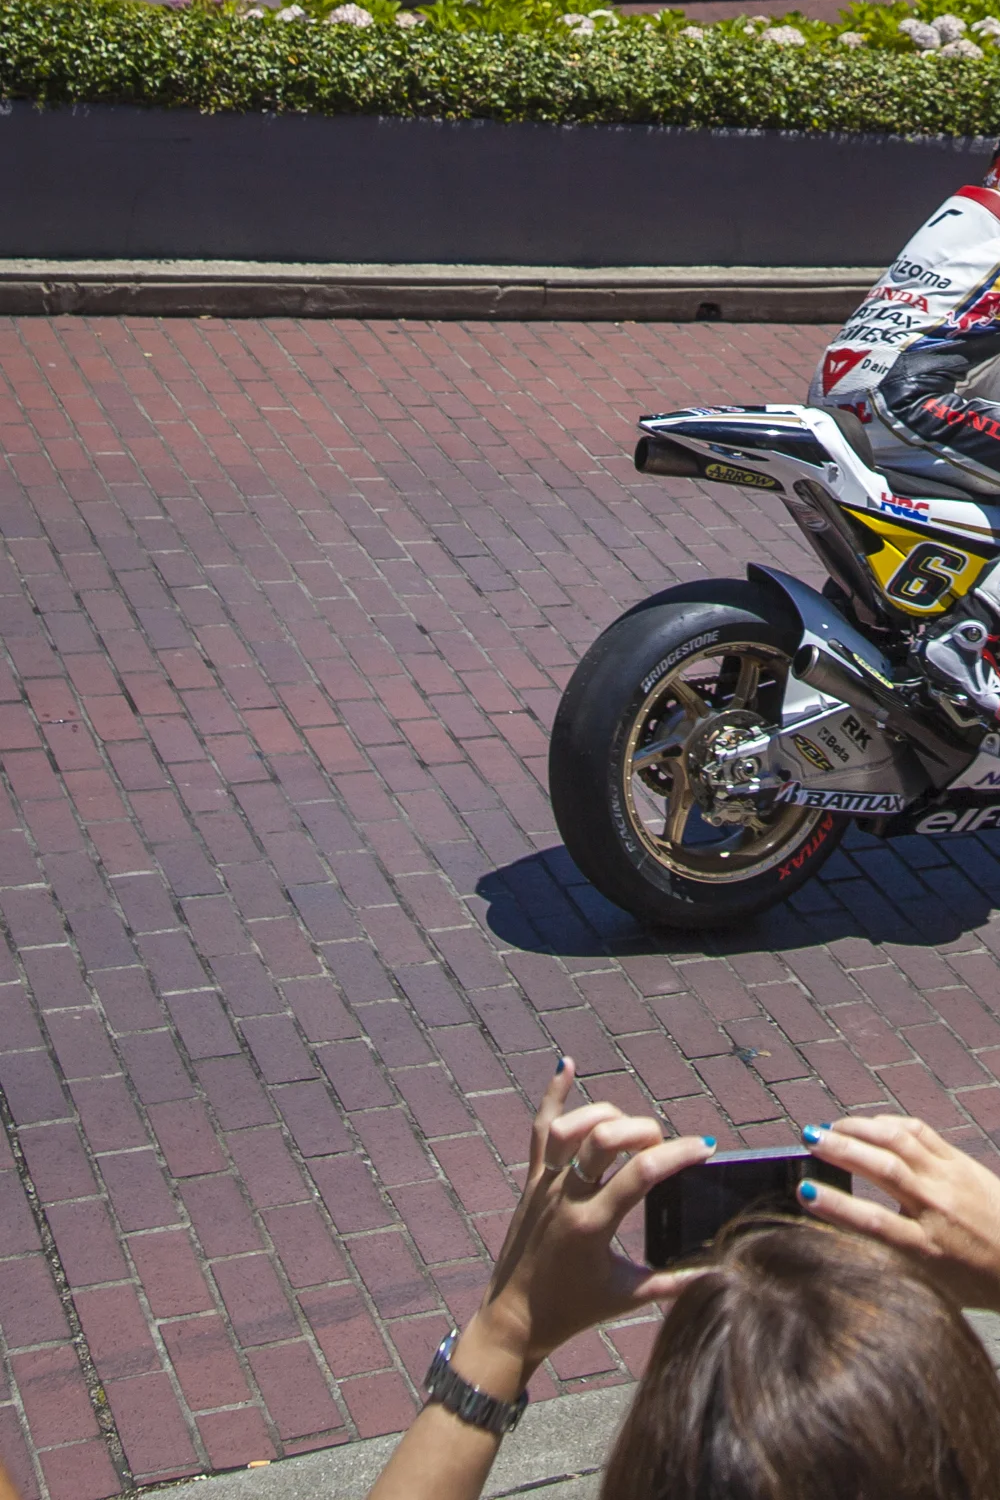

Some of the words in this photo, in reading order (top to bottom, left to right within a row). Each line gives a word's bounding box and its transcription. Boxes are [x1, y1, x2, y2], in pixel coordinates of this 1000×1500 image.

[708, 465, 773, 487] ARROW
[880, 491, 930, 523] HRC
[885, 541, 970, 609] 6
[640, 630, 720, 694] BRIDGESTONE
[825, 734, 850, 763] Beta
[842, 714, 873, 751] RK
[804, 791, 904, 812] BATTLAX
[778, 812, 834, 881] ATTLAX
